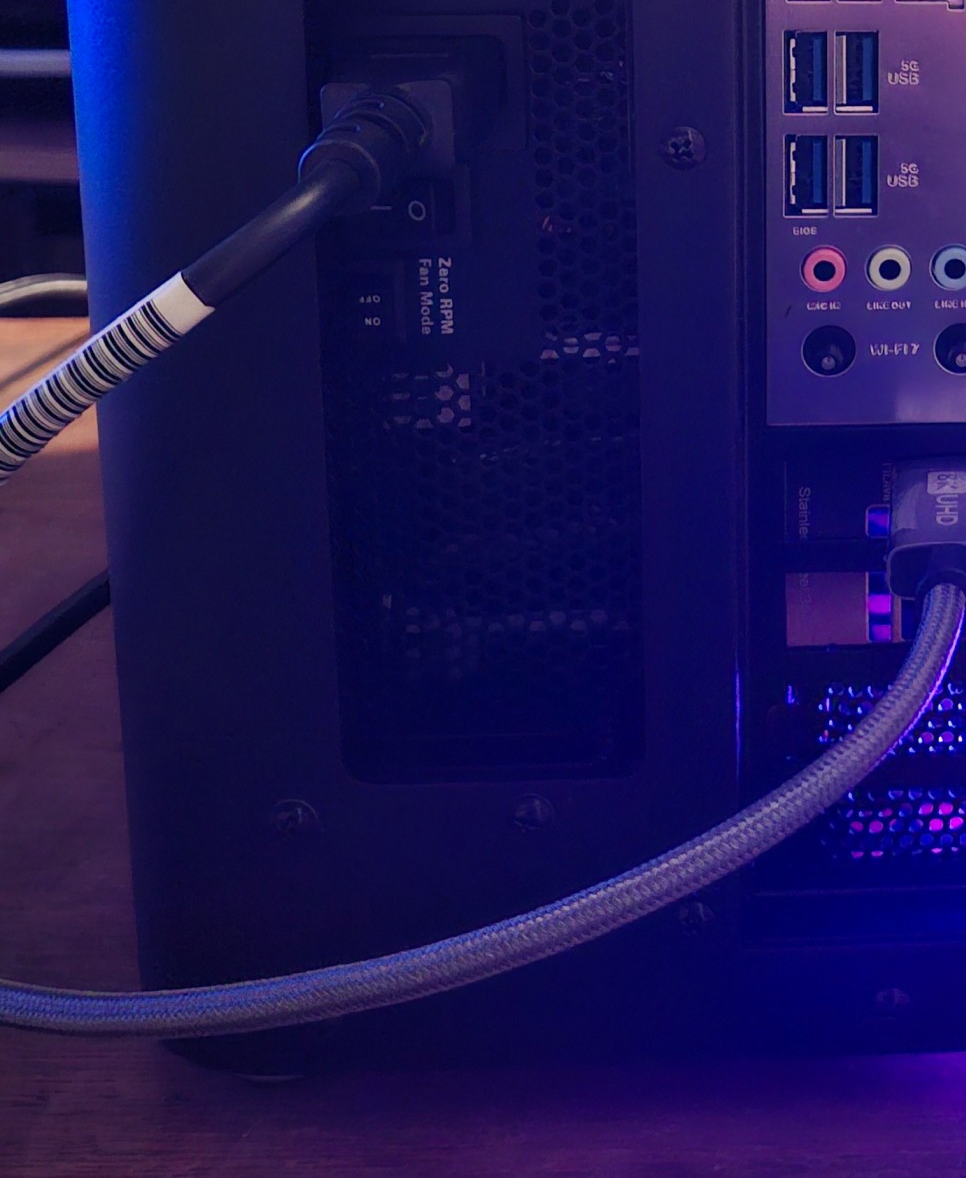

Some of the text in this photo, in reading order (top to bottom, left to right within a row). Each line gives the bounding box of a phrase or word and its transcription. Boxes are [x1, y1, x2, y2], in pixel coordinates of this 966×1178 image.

[888, 72, 920, 85] USB
[887, 174, 919, 187] USB
[419, 258, 434, 335] Fan Mode
[438, 257, 454, 335] Zero RPM
[935, 494, 959, 526] UHD
